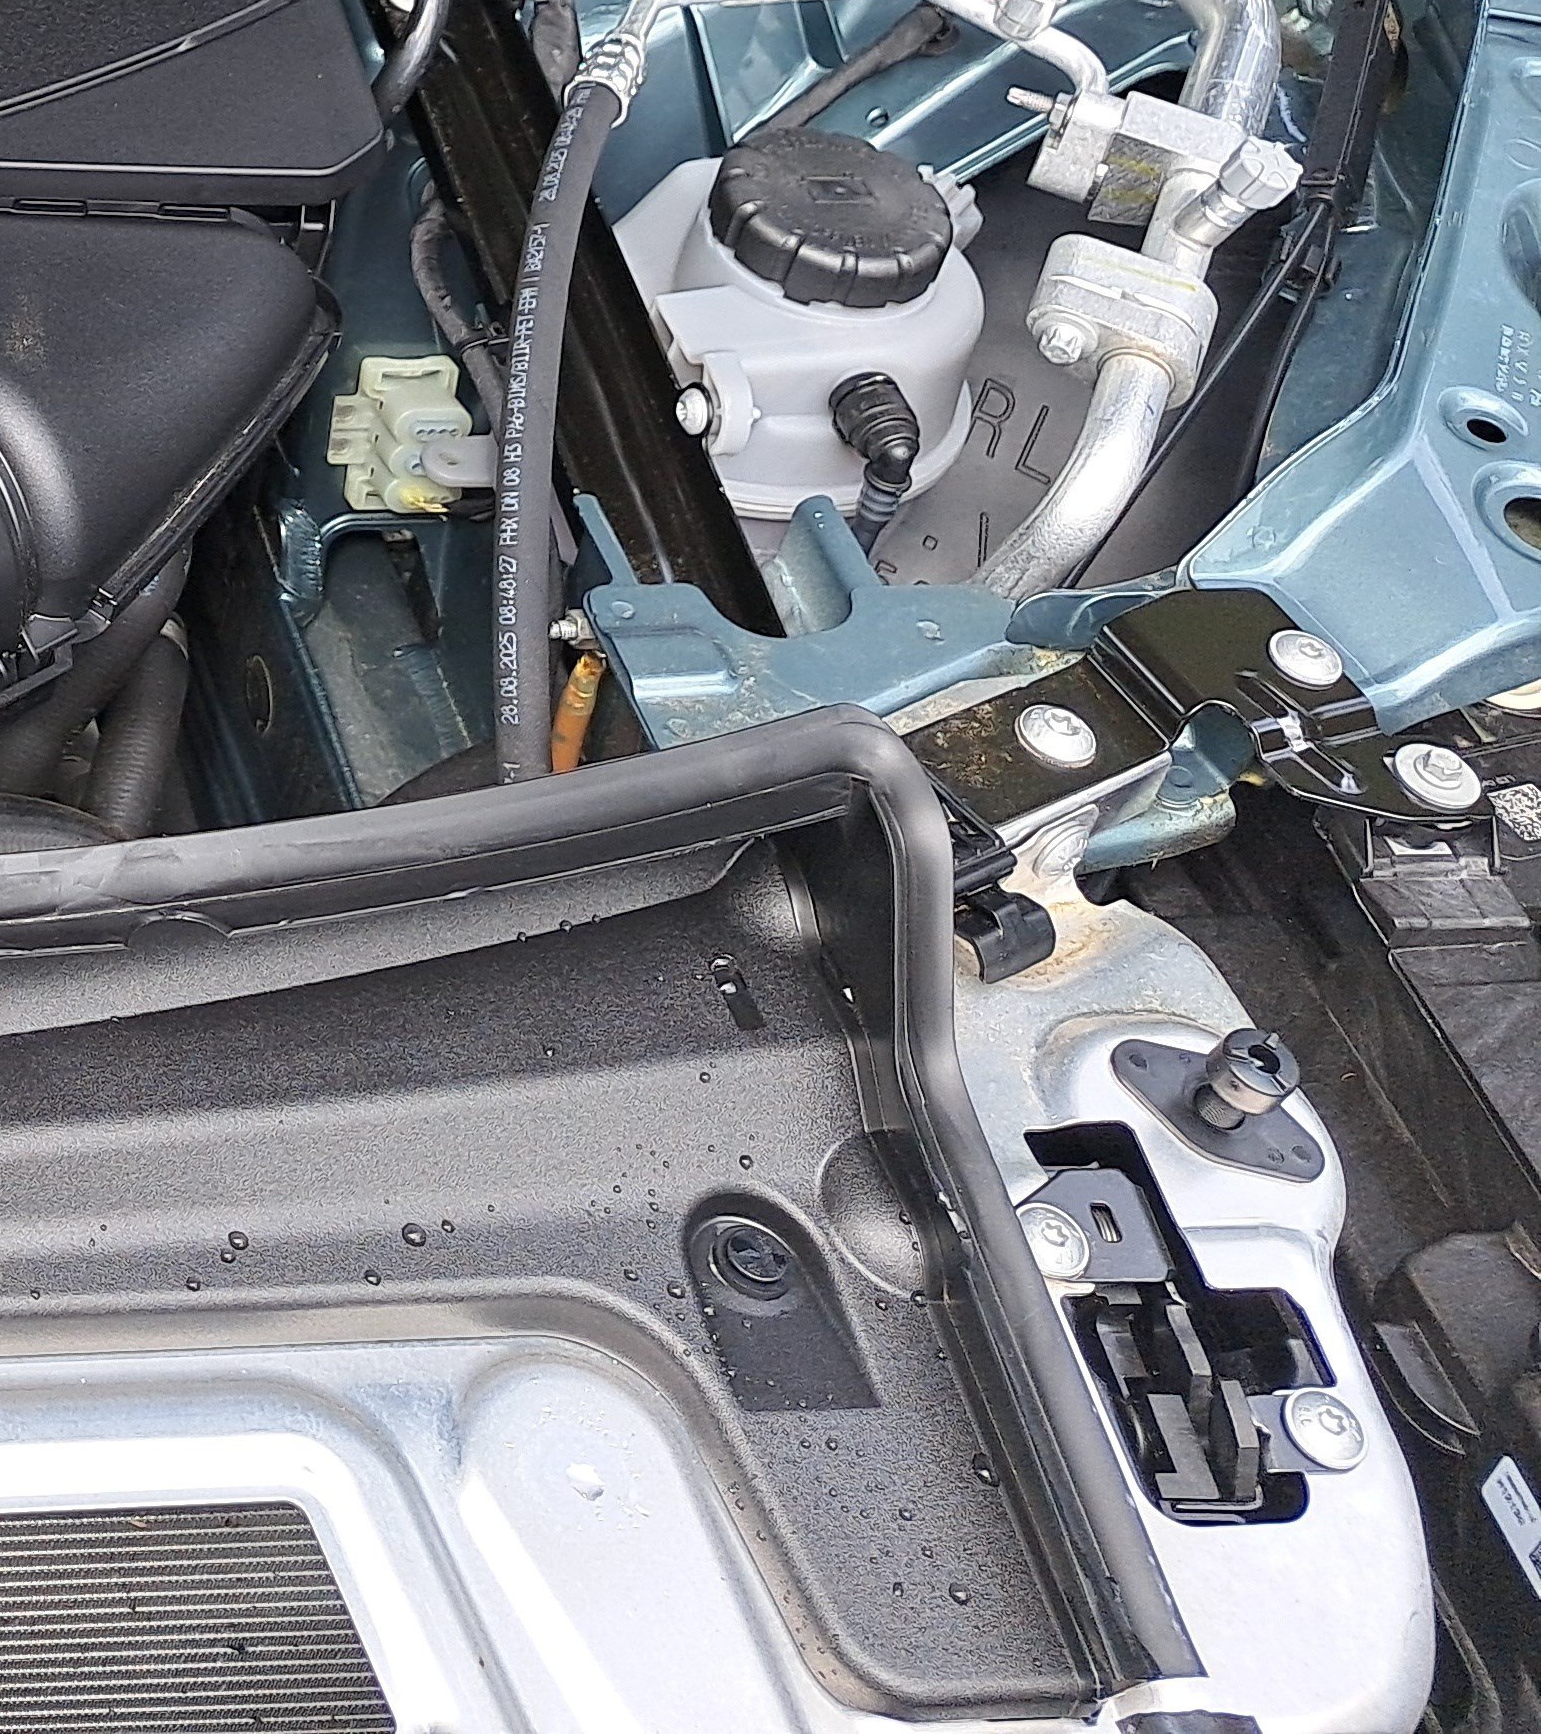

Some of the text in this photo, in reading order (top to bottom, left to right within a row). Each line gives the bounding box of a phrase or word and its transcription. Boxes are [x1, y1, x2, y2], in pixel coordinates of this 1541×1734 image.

[502, 467, 522, 486] 08
[498, 554, 518, 625] 08:48:27
[498, 630, 520, 725] 28.08.2025
